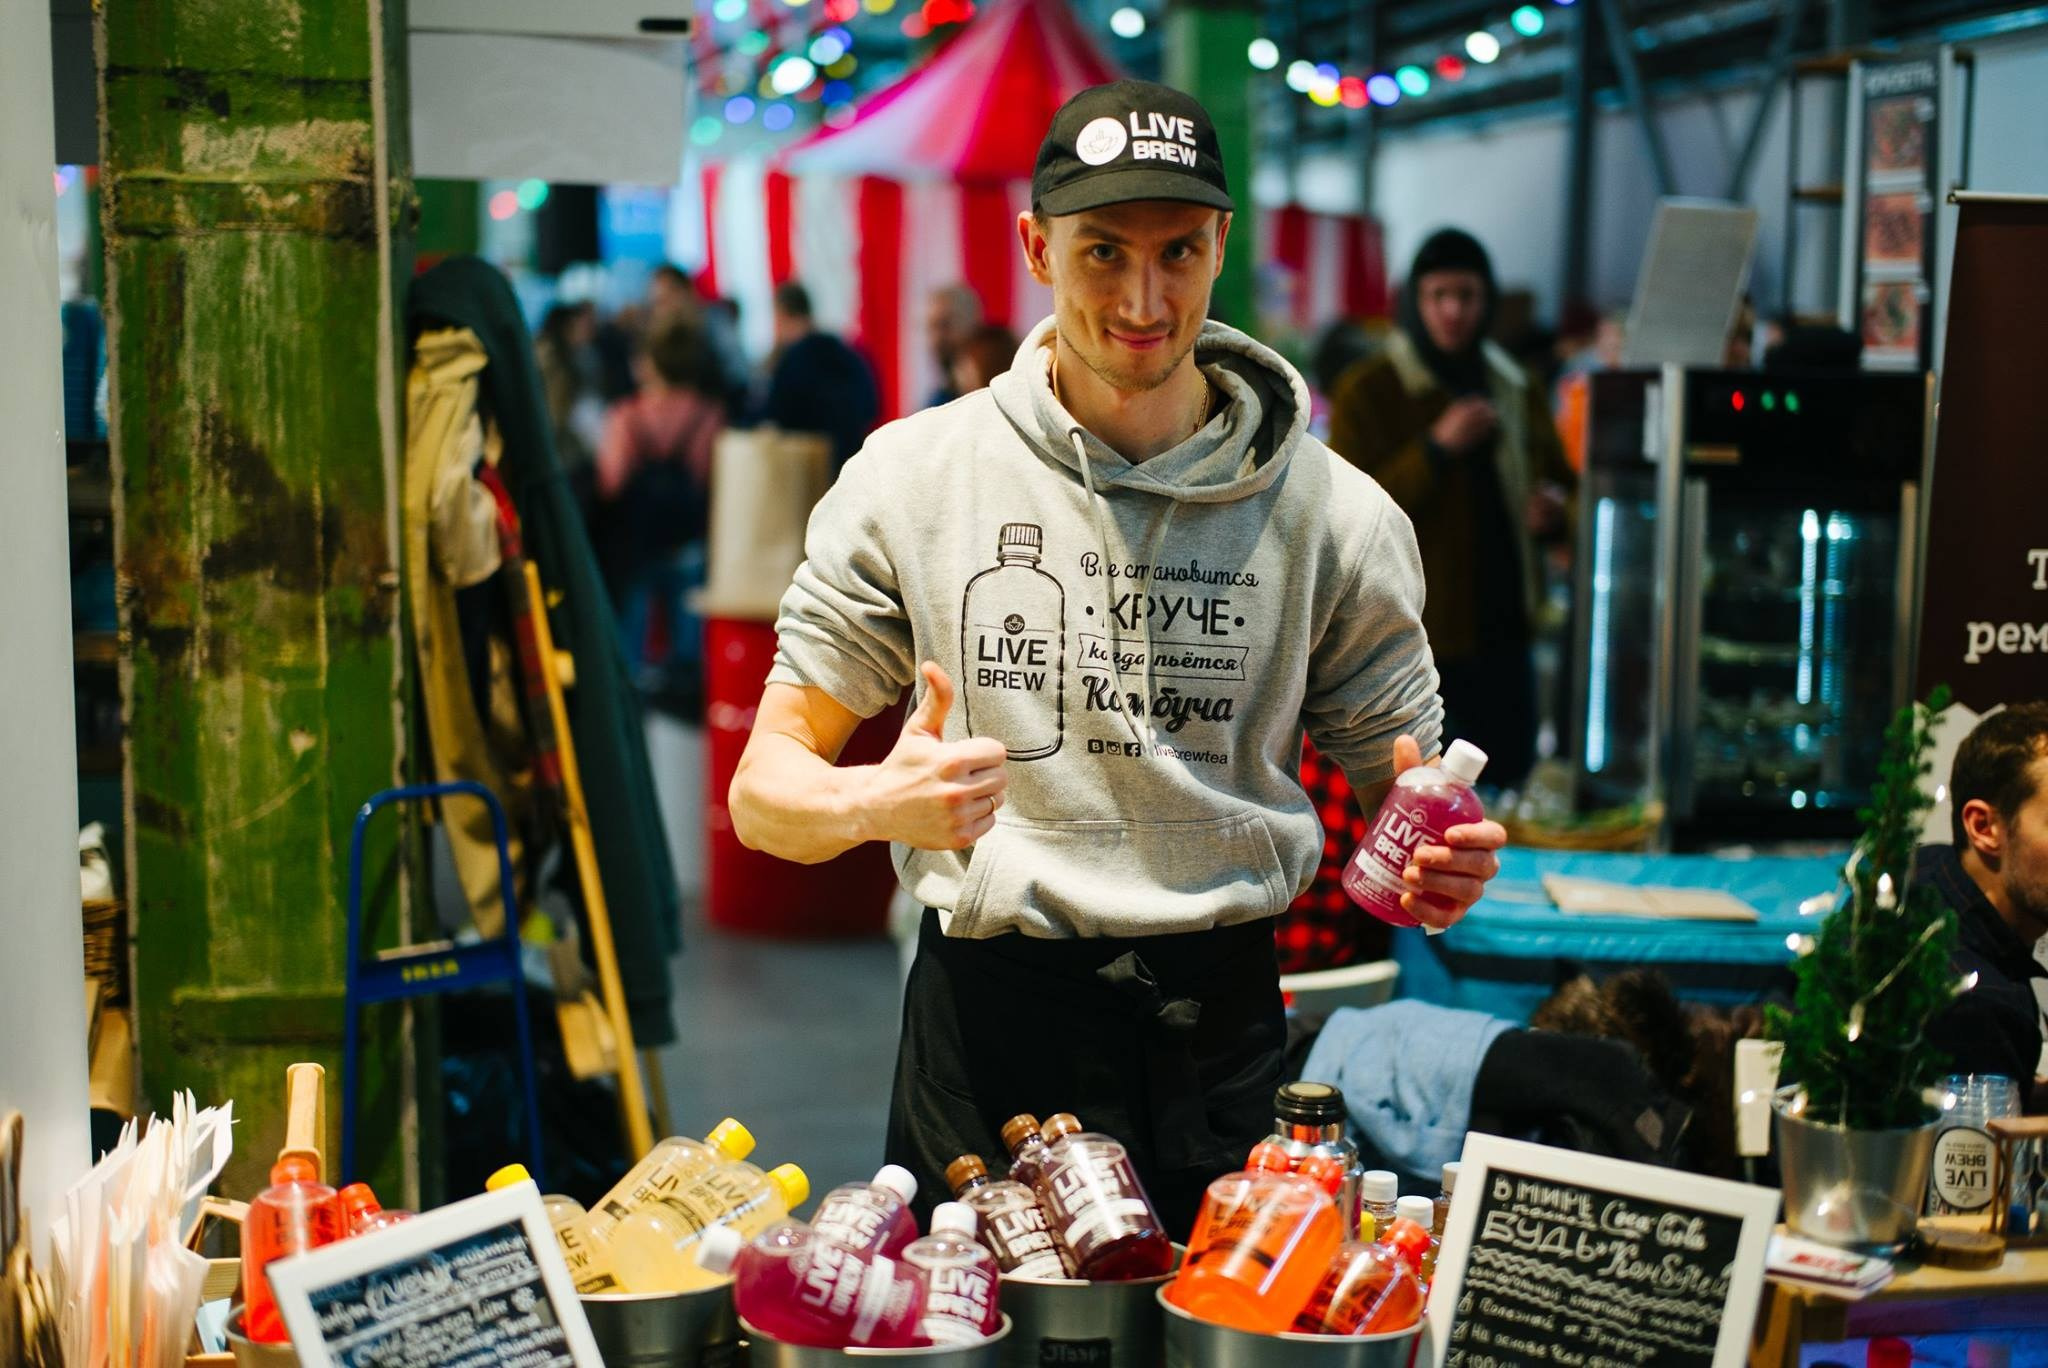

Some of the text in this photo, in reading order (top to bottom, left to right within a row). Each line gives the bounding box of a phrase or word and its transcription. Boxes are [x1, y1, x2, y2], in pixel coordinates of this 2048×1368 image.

[1129, 111, 1196, 147] LIVE
[1132, 140, 1197, 168] BREW
[1124, 559, 1260, 588] становится
[1102, 593, 1231, 636] КРУЧЕ
[977, 635, 1048, 666] LIVE
[1088, 641, 1239, 671] когда пьётся
[1964, 621, 2048, 664] рем
[977, 668, 1046, 691] BREW
[1082, 675, 1235, 733] Комбуча
[1945, 1153, 1987, 1167] BREW
[1945, 1169, 1987, 1187] LIVE
[995, 1208, 1047, 1240] LIVE
[930, 1266, 991, 1306] LIVE
